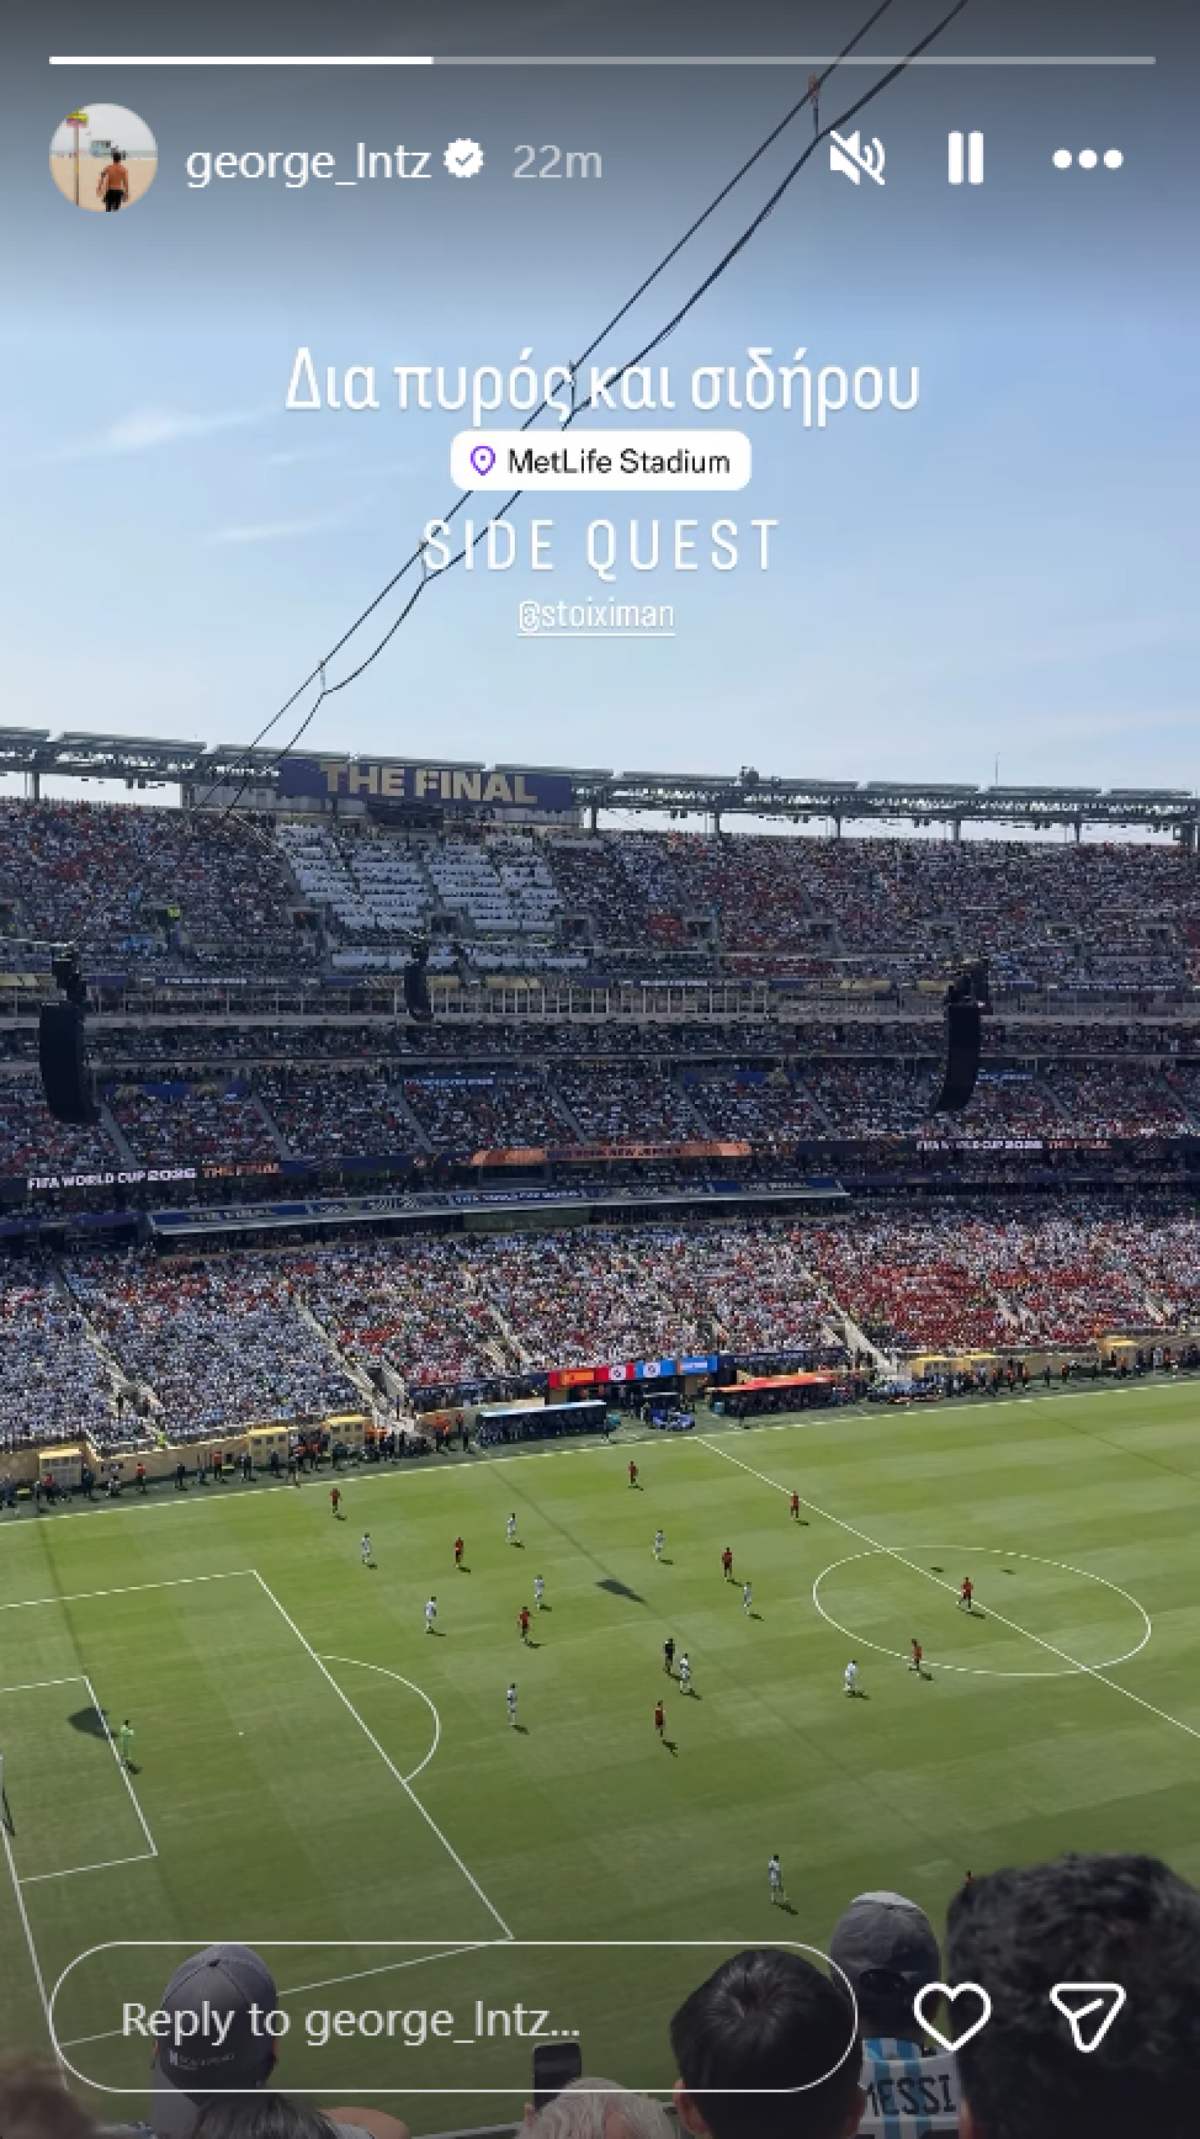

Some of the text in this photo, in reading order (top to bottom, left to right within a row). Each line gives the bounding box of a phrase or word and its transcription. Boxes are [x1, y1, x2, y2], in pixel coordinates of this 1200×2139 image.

[320, 761, 538, 805] THE FINAL
[27, 1177, 60, 1190] FIFA
[61, 1173, 114, 1188] WORLD
[118, 1170, 146, 1184] CUP
